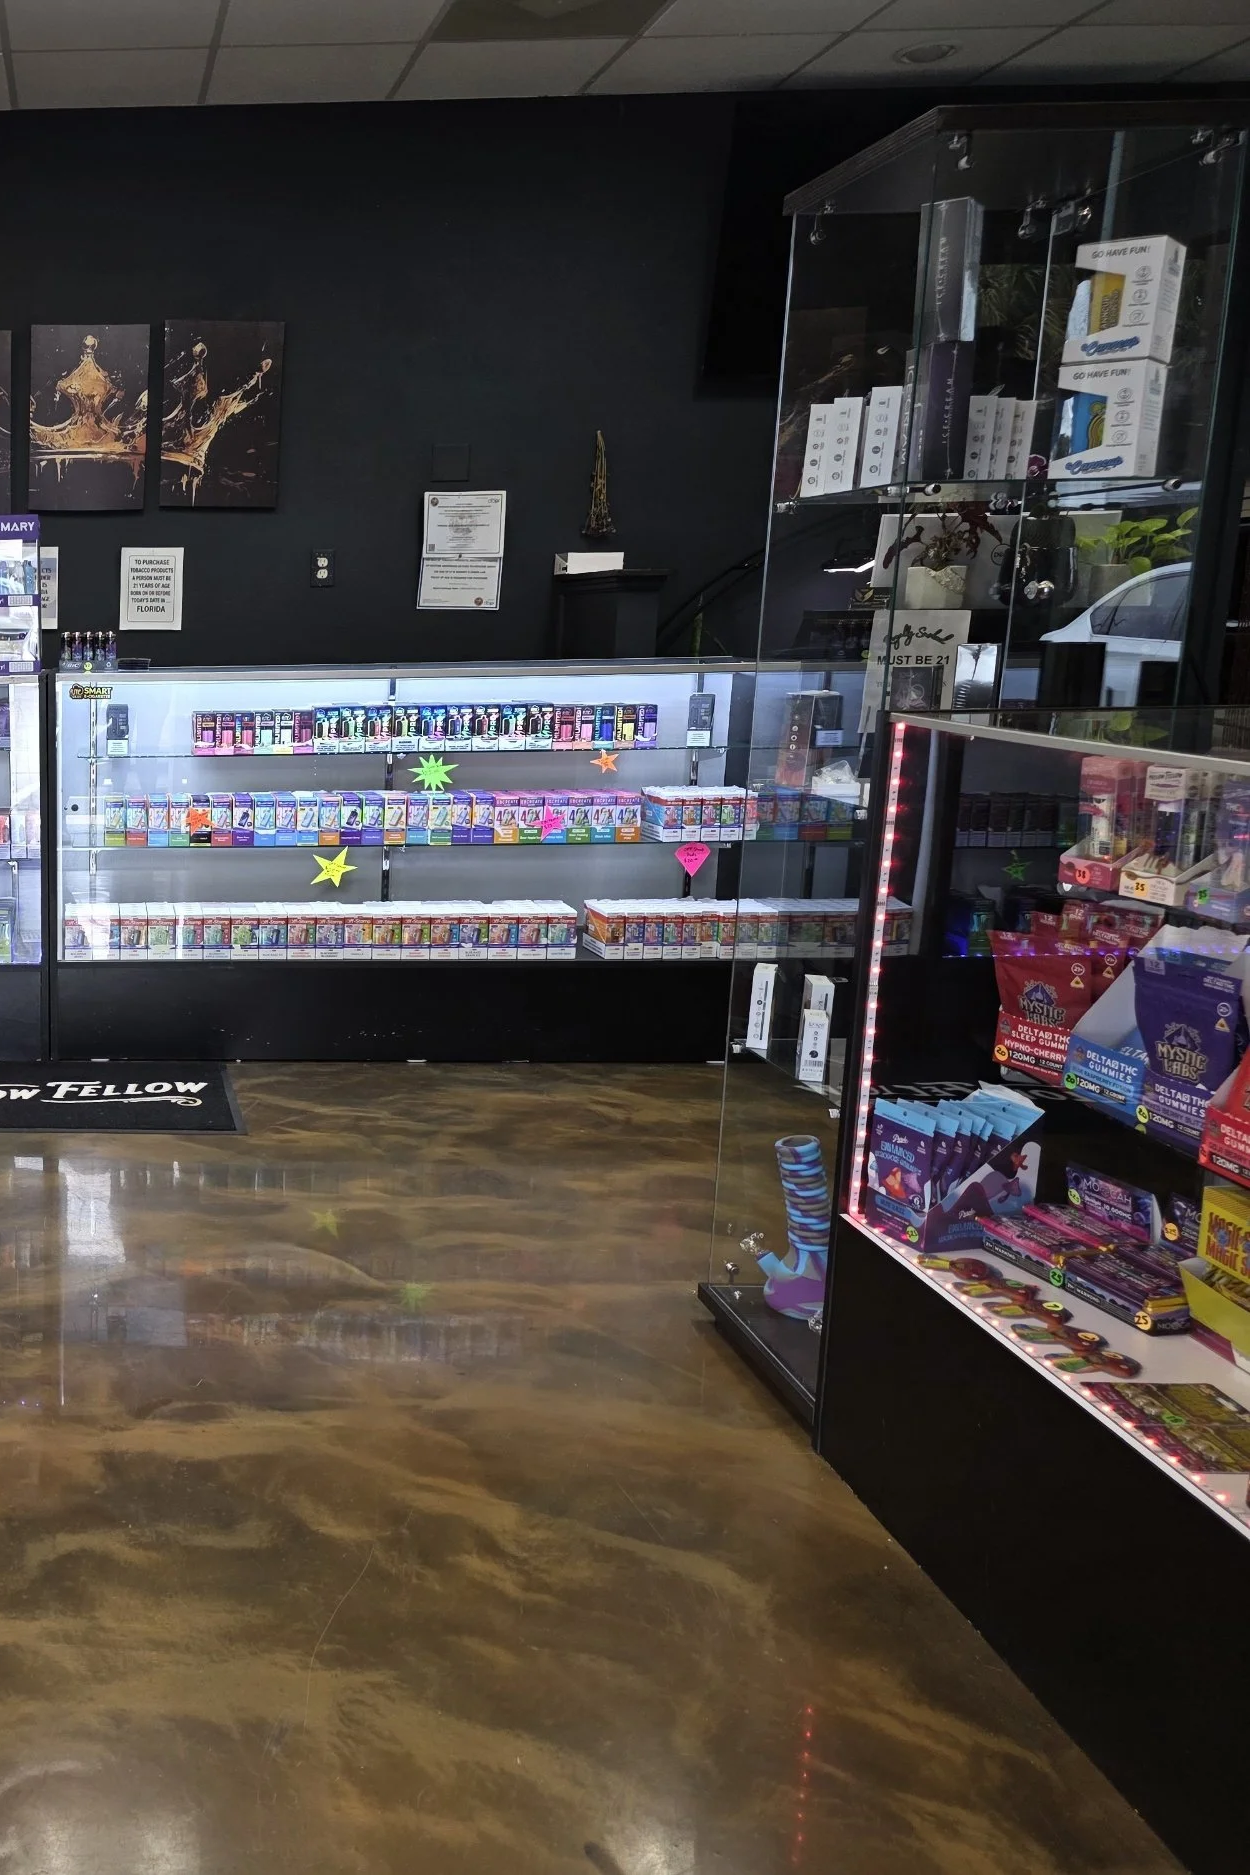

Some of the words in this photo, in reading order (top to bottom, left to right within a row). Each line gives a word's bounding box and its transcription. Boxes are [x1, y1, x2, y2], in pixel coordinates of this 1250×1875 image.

[1092, 251, 1104, 259] GO
[1105, 248, 1128, 257] HAVE
[1129, 245, 1150, 255] FUN!
[1073, 372, 1085, 380] GO
[1087, 370, 1109, 378] HAVE
[1, 521, 35, 532] MARY
[877, 656, 911, 665] MUST
[915, 656, 932, 665] BE
[936, 655, 950, 665] 21
[84, 686, 112, 695] SMART
[1019, 996, 1065, 1023] MYSTIC
[1011, 1030, 1036, 1043] SLEEP
[1004, 1038, 1067, 1062] HYPNO-CHERRY
[1009, 1051, 1036, 1064] 120MG
[1156, 1044, 1207, 1072] MYSTIC
[1089, 1062, 1132, 1083] GUMMIES
[1119, 1062, 1138, 1076] THC
[1164, 1058, 1199, 1081] LABS
[46, 1081, 208, 1099] FELLOW
[1076, 1077, 1100, 1093] 120MG
[1158, 1095, 1206, 1118] GUMMIES
[1149, 1111, 1175, 1128] 120MG
[1212, 1154, 1240, 1173] 120MG
[1135, 1315, 1148, 1325] 25
